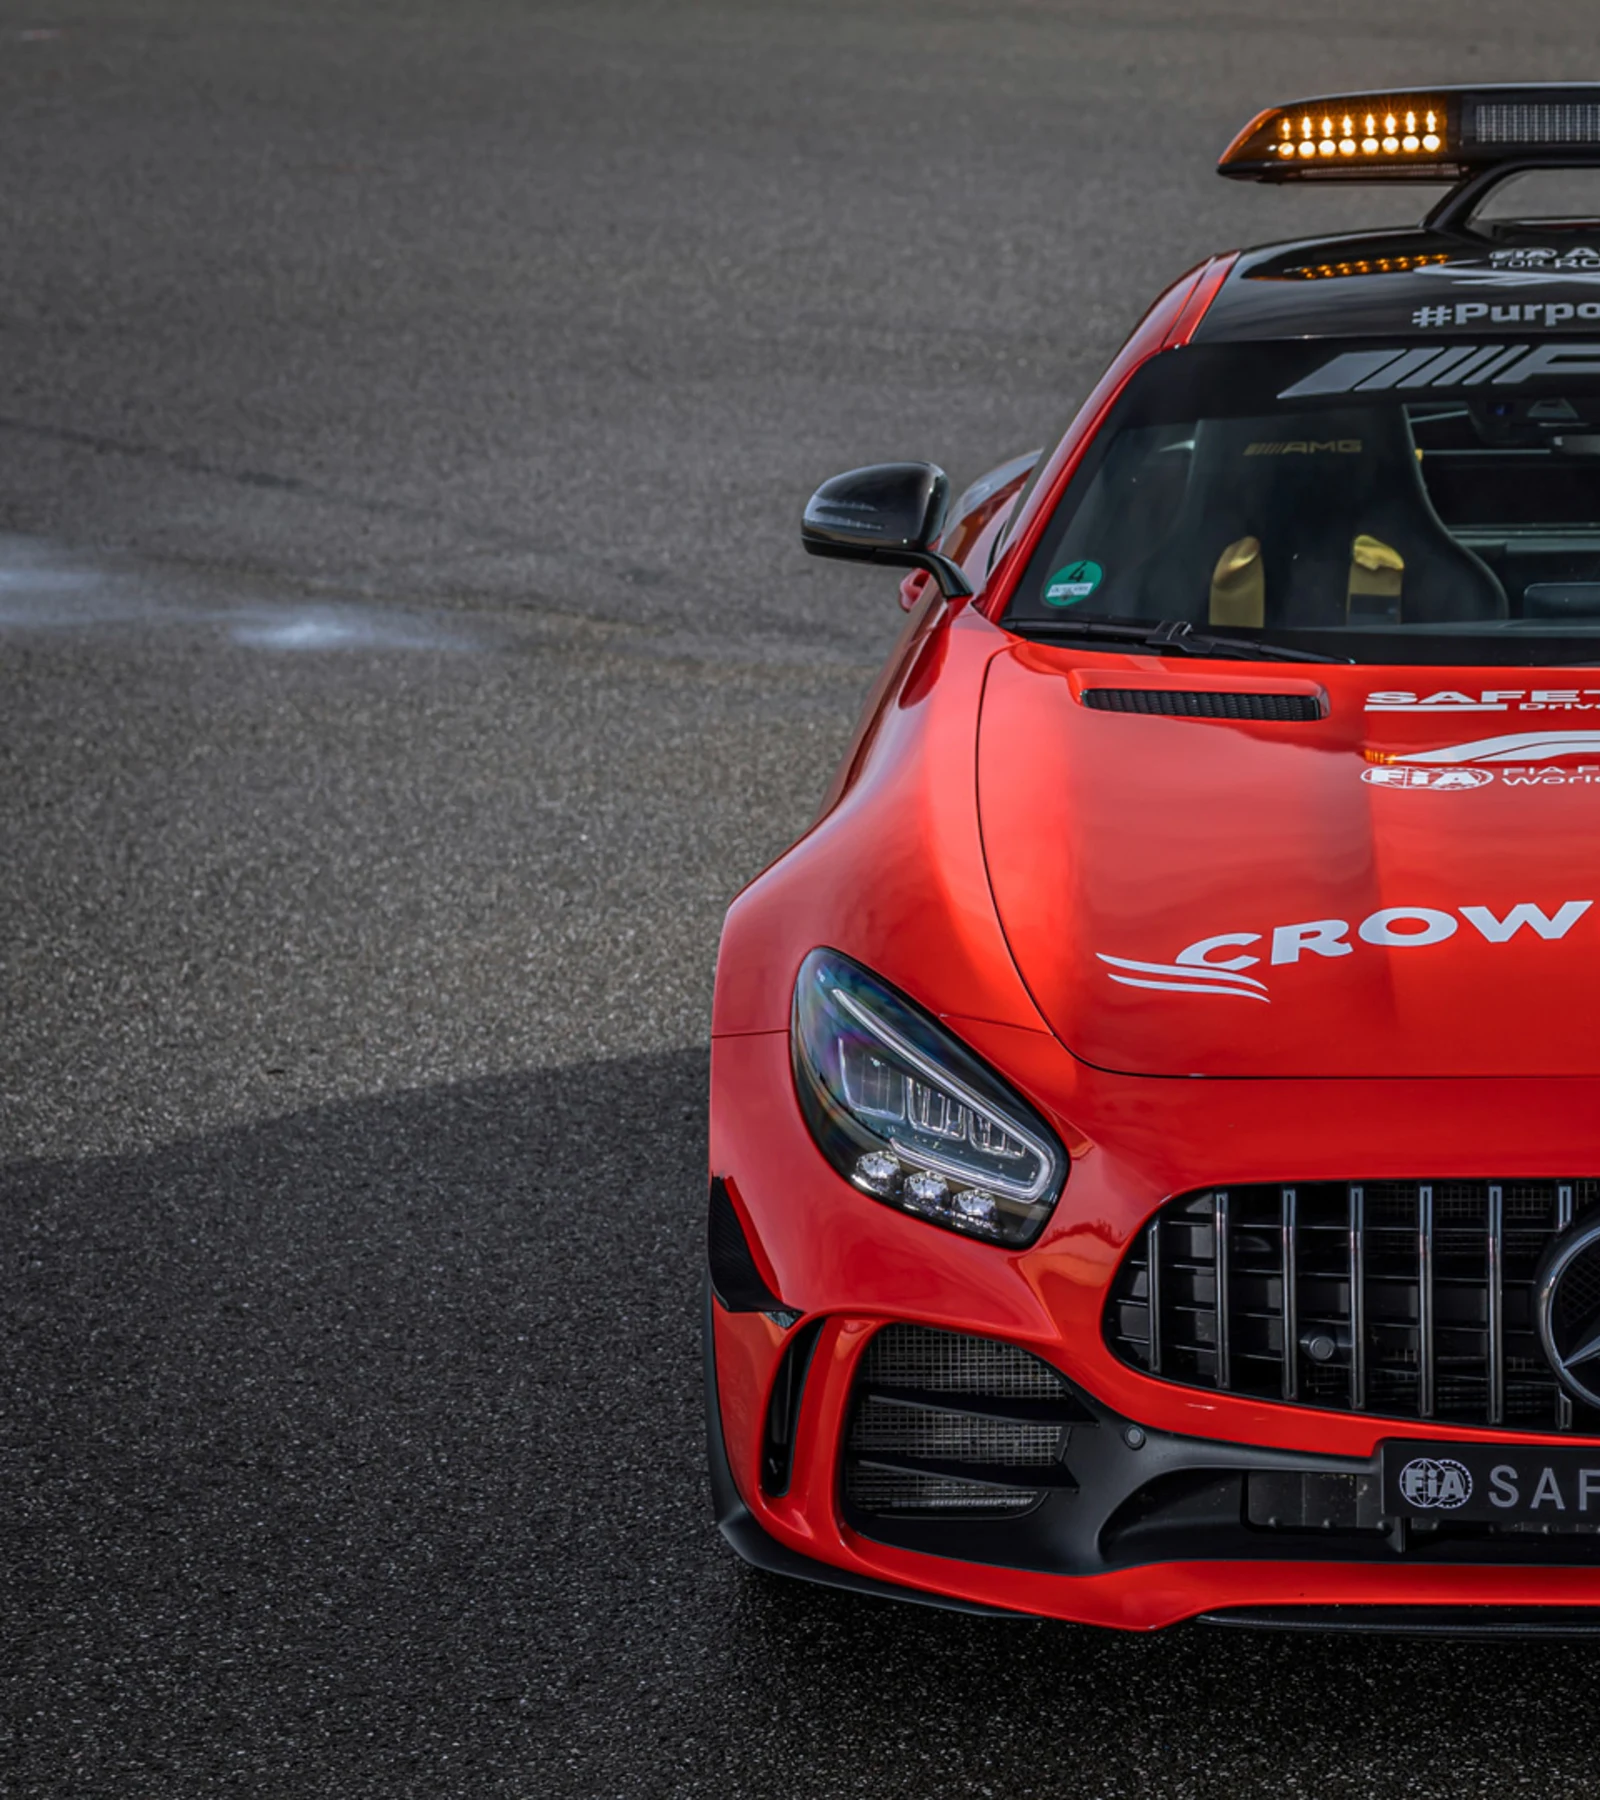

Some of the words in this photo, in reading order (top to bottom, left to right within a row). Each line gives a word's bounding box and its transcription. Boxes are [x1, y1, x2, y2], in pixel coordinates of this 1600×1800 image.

[1492, 258, 1545, 268] FOR
[1281, 439, 1363, 455] AMG
[1067, 560, 1088, 582] 4
[1502, 767, 1567, 776] FIA
